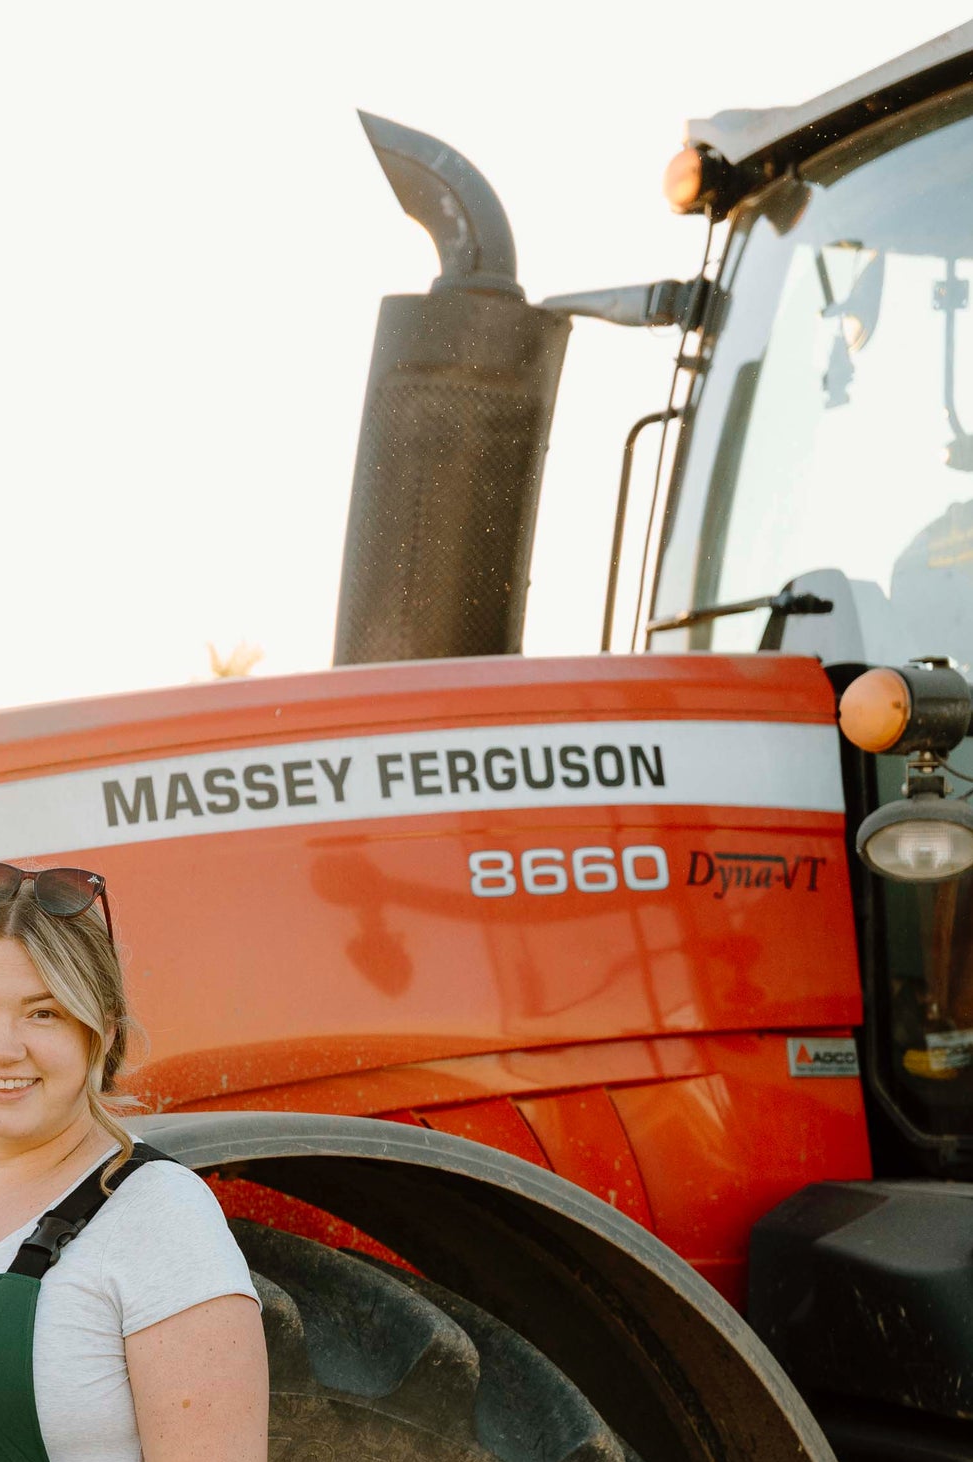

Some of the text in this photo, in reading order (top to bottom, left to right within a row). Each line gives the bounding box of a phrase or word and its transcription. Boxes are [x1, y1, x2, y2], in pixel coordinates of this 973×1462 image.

[102, 745, 665, 827] MASSEY FERGUSON
[468, 845, 669, 898] 8660
